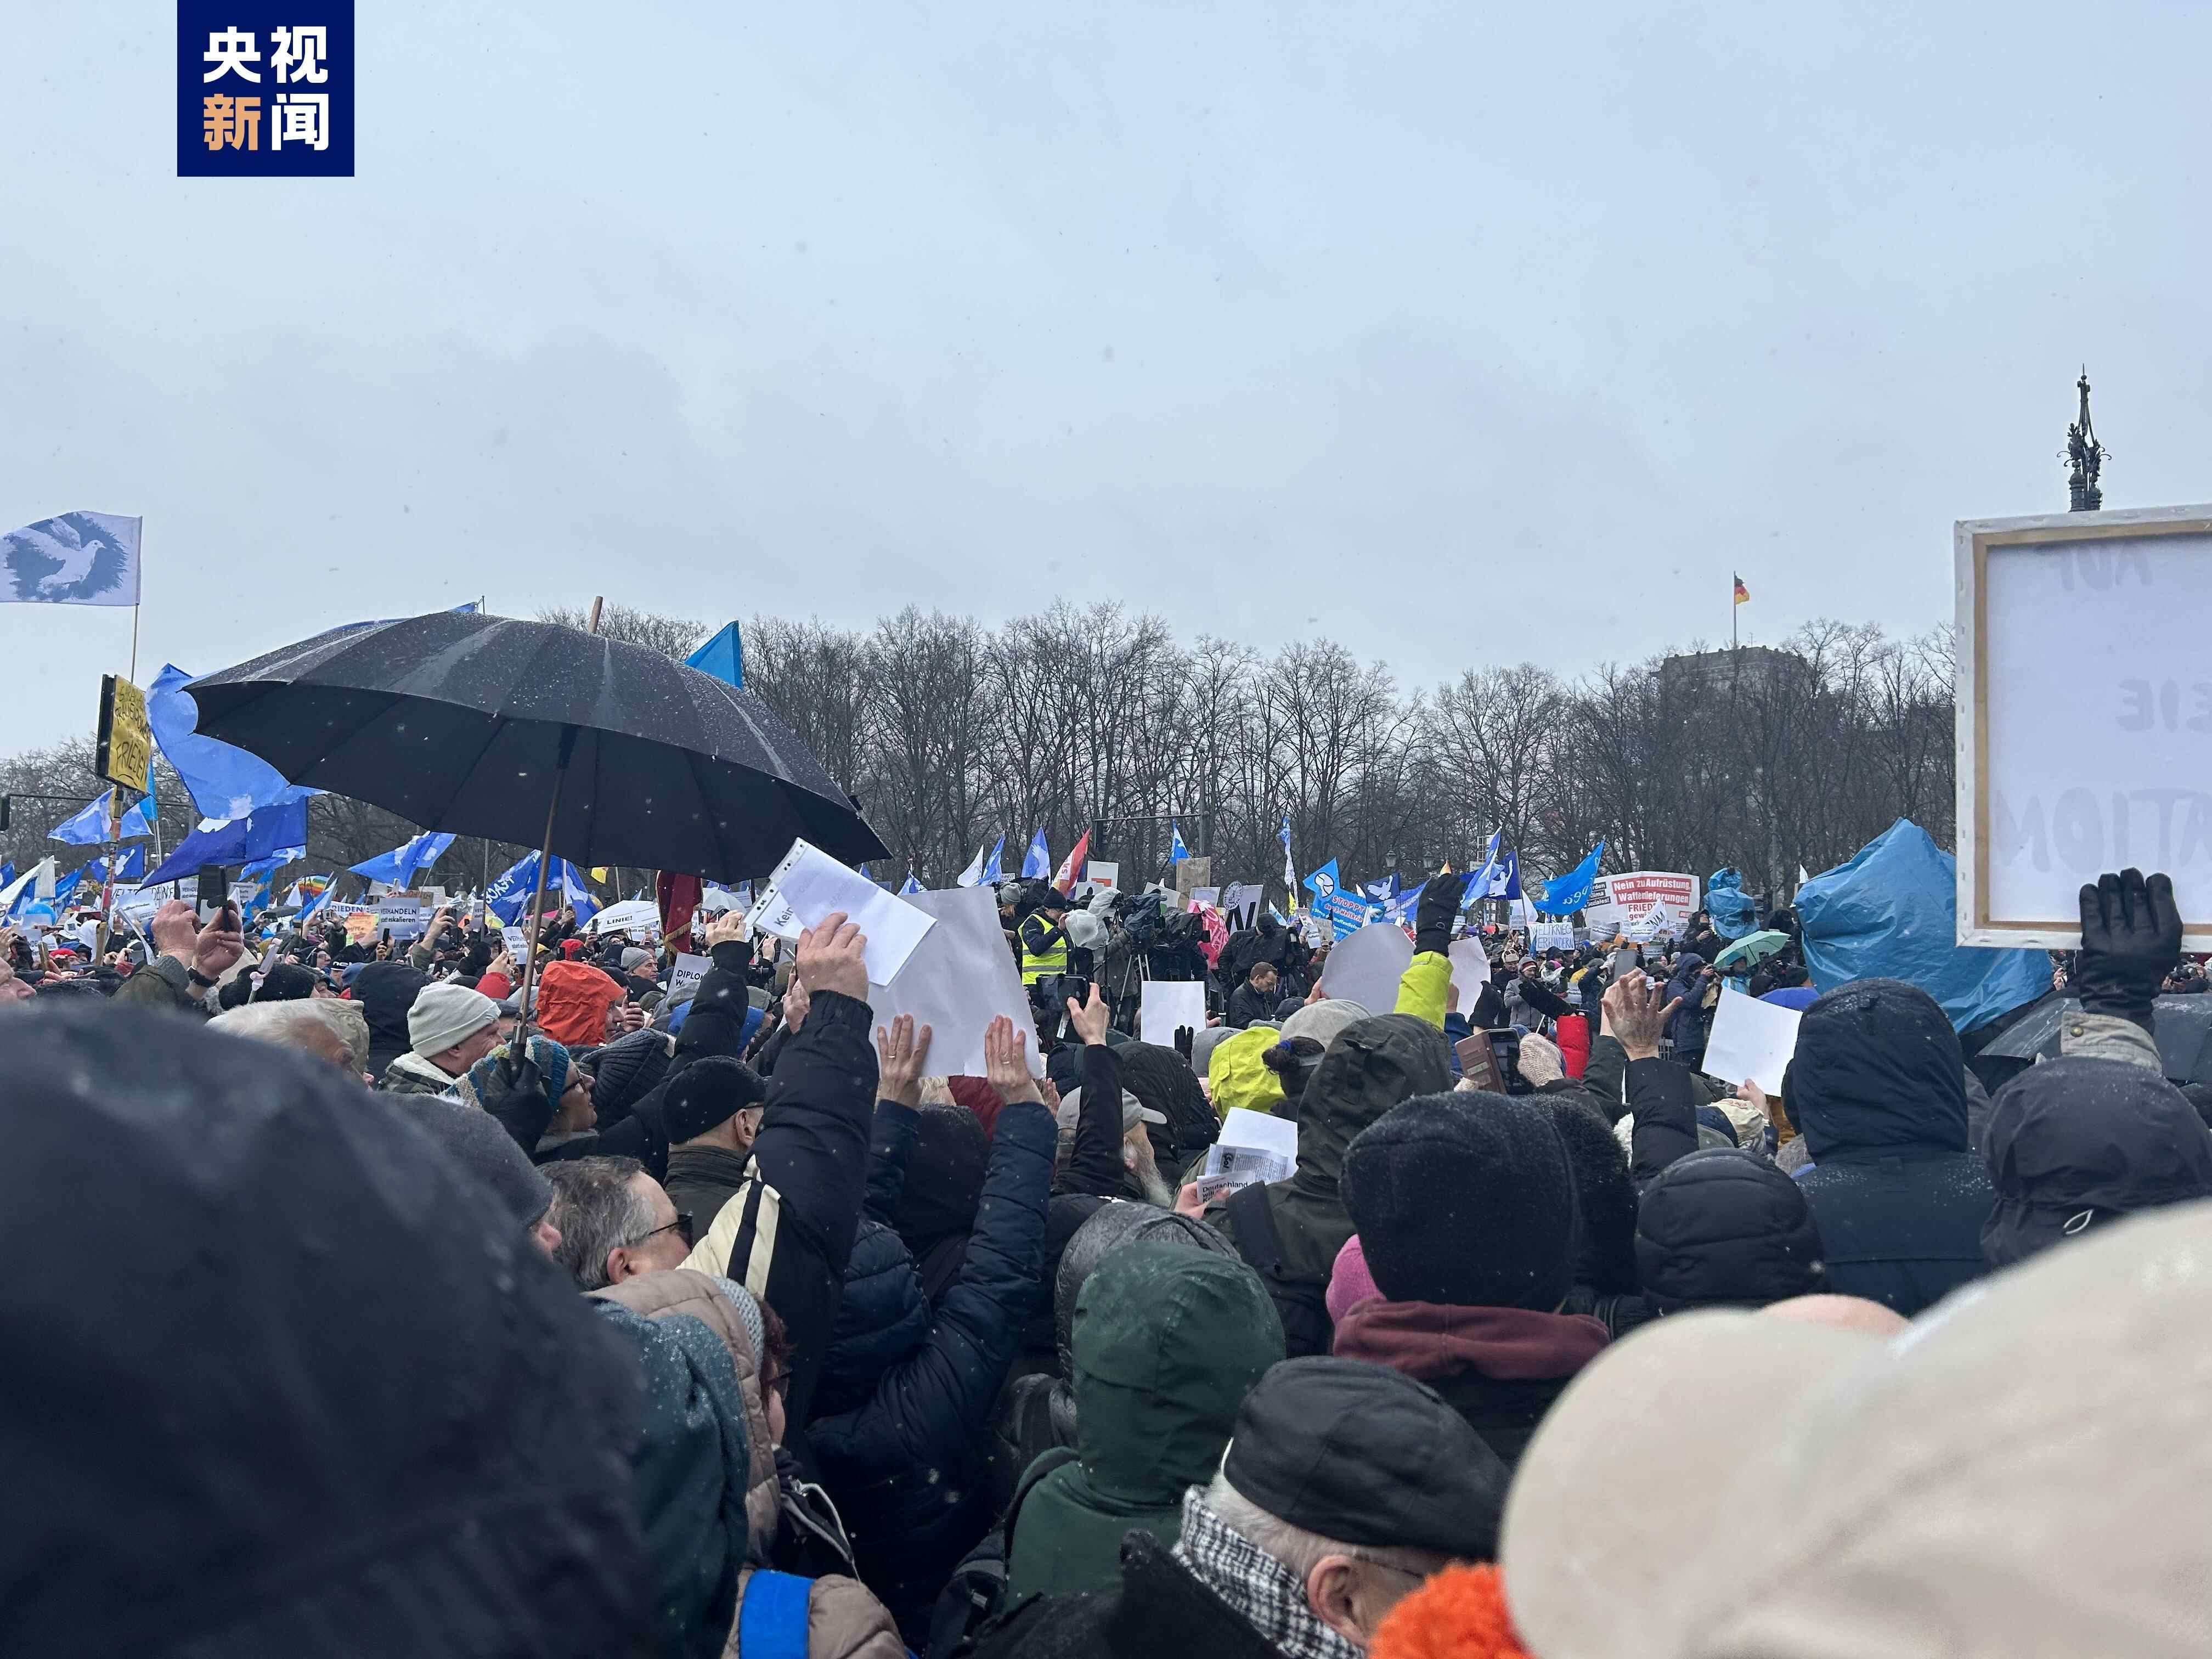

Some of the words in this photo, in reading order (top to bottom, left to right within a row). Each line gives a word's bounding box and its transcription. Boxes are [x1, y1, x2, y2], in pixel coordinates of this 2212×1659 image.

[1613, 881, 1634, 891] Nein
[1646, 878, 1691, 890] Aufrüstung,
[1333, 895, 1365, 913] STOPPT
[1628, 903, 1656, 912] FRIED
[607, 916, 633, 924] LINIE!
